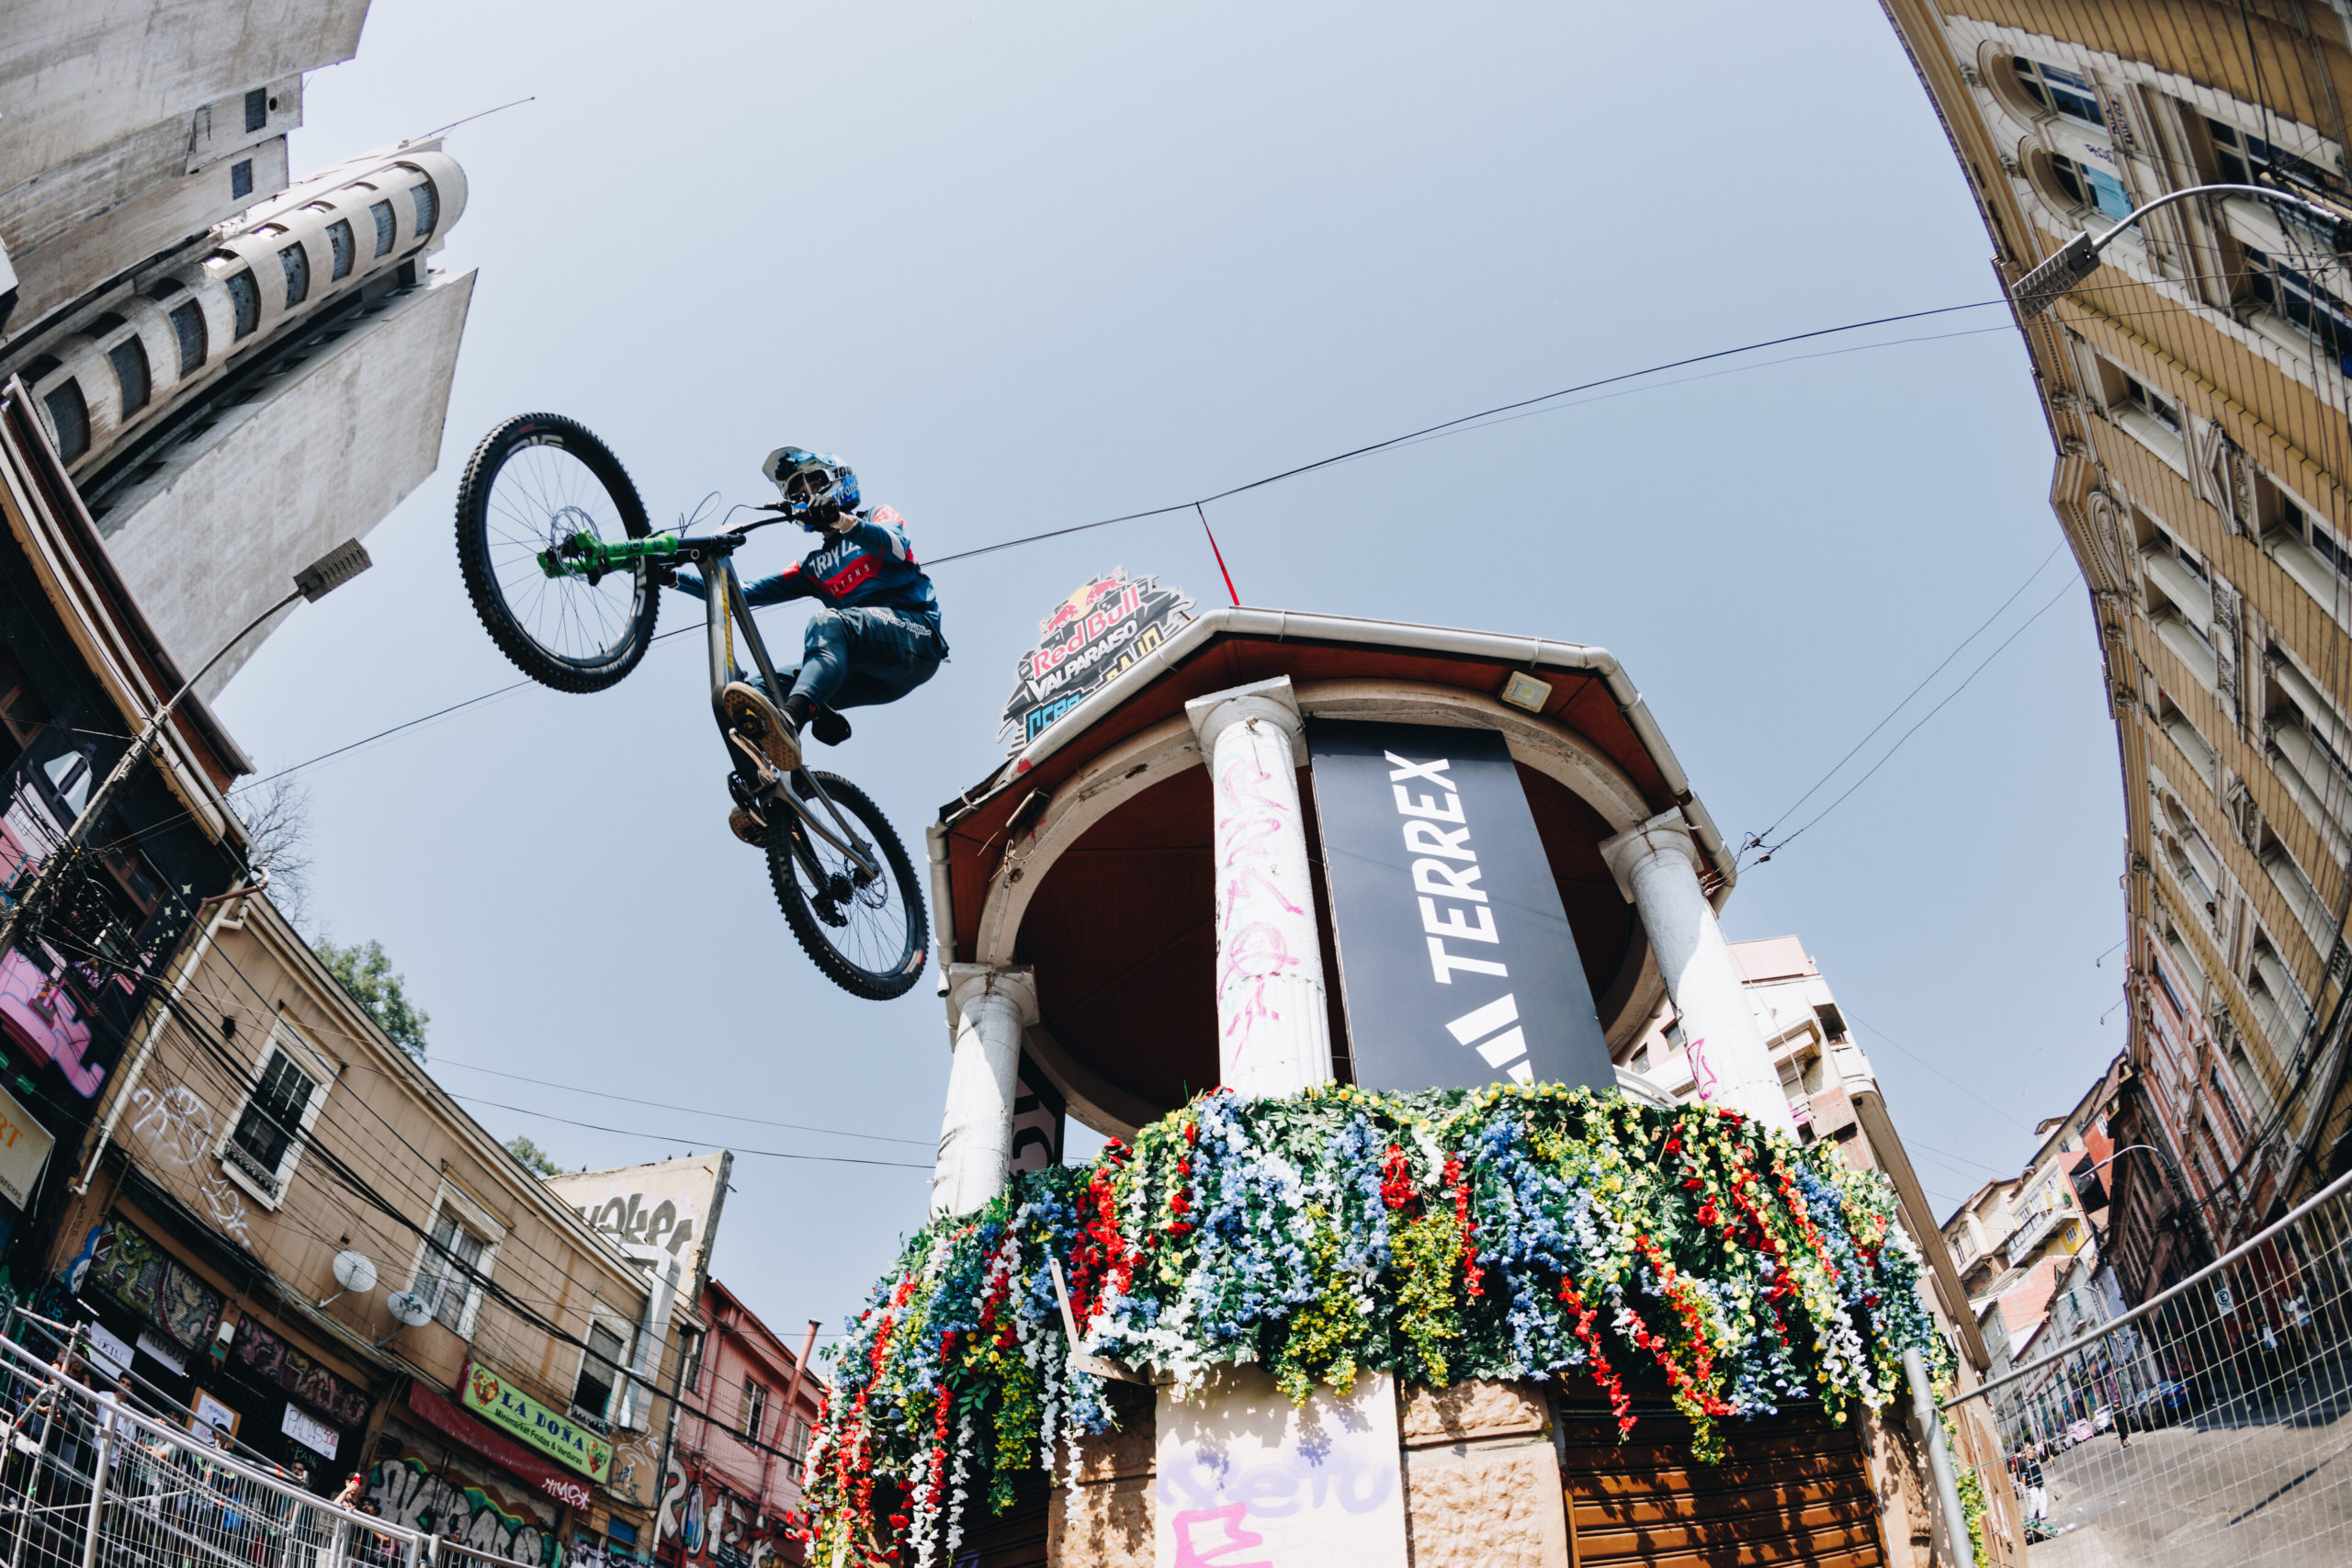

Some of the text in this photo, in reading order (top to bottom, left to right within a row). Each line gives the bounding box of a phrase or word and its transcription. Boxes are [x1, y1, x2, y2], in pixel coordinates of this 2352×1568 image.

[1026, 619, 1138, 703] VALPARAISO
[1034, 585, 1140, 678] Red Bull
[1385, 750, 1509, 985] TERREX
[494, 1408, 582, 1466] Minimarket Frutas & Verduras
[500, 1389, 584, 1452] LA DOÑA
